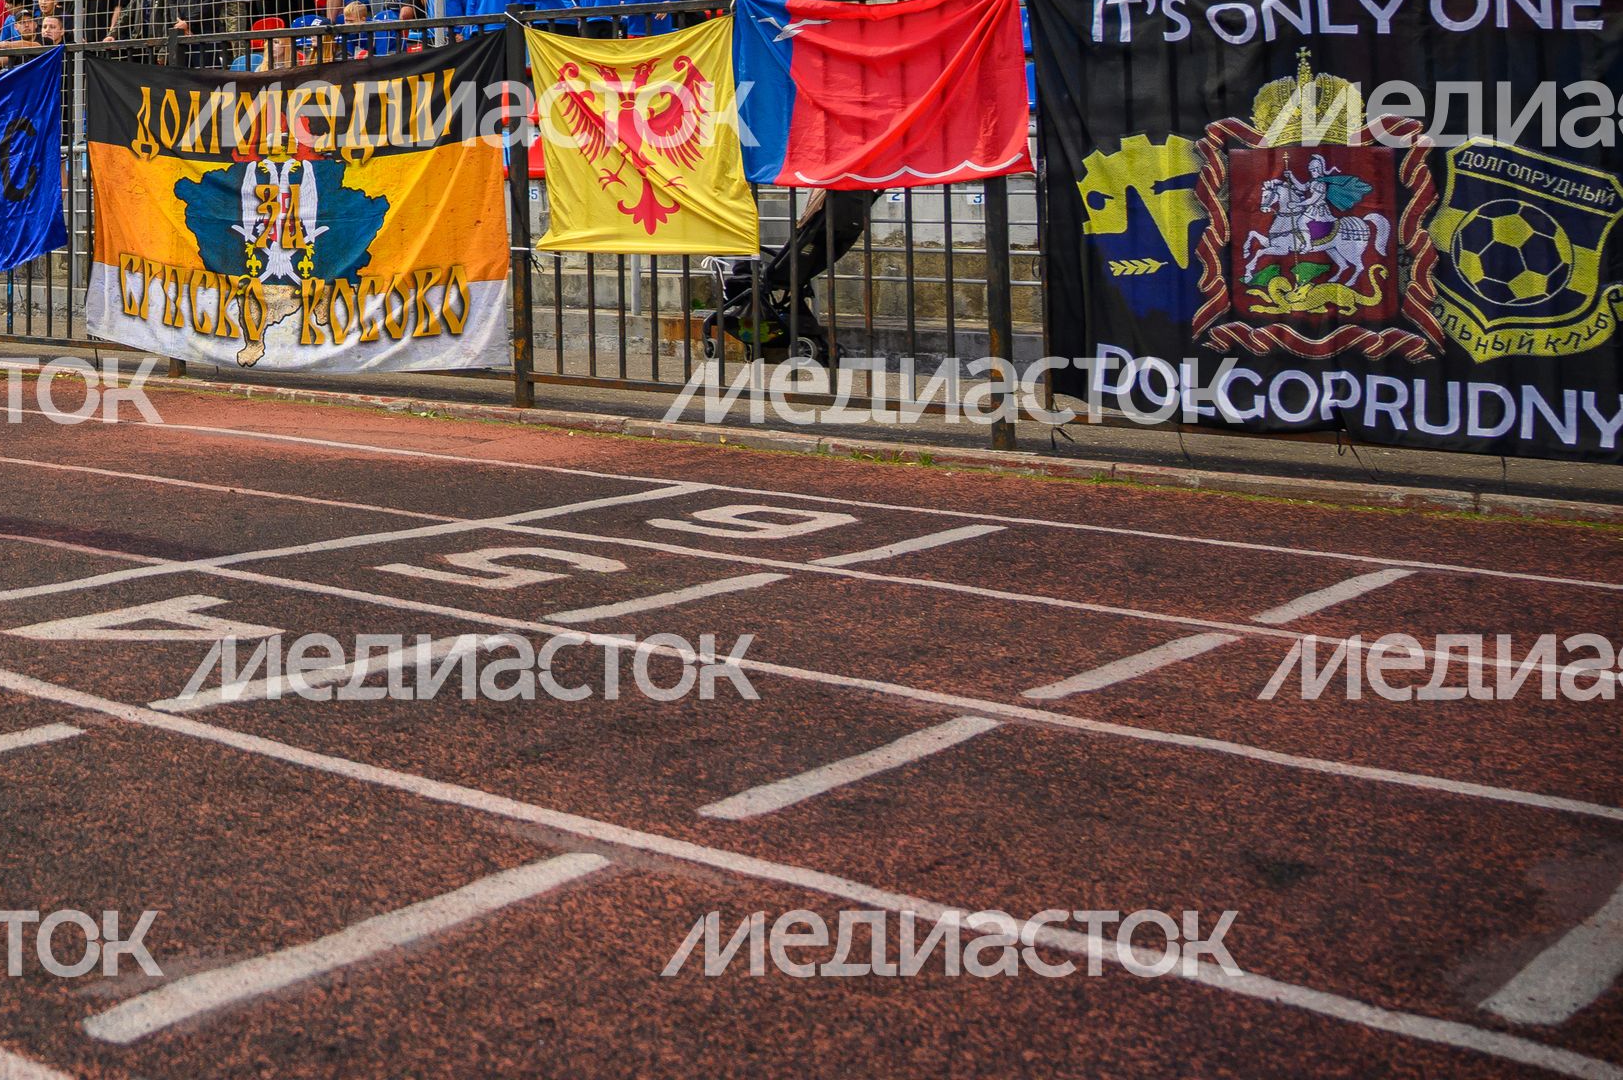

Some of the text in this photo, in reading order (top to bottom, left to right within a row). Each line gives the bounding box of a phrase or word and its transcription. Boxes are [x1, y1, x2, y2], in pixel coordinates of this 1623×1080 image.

[1458, 150, 1616, 207] ДОЛГОПРУДНЫЙ
[255, 183, 307, 249] ЗА
[119, 252, 471, 345] СРПСКО КОСОВО
[1544, 311, 1610, 354] КЛУБ
[1091, 342, 1623, 449] DOLGOPRUDNY
[1, 593, 287, 642] 4
